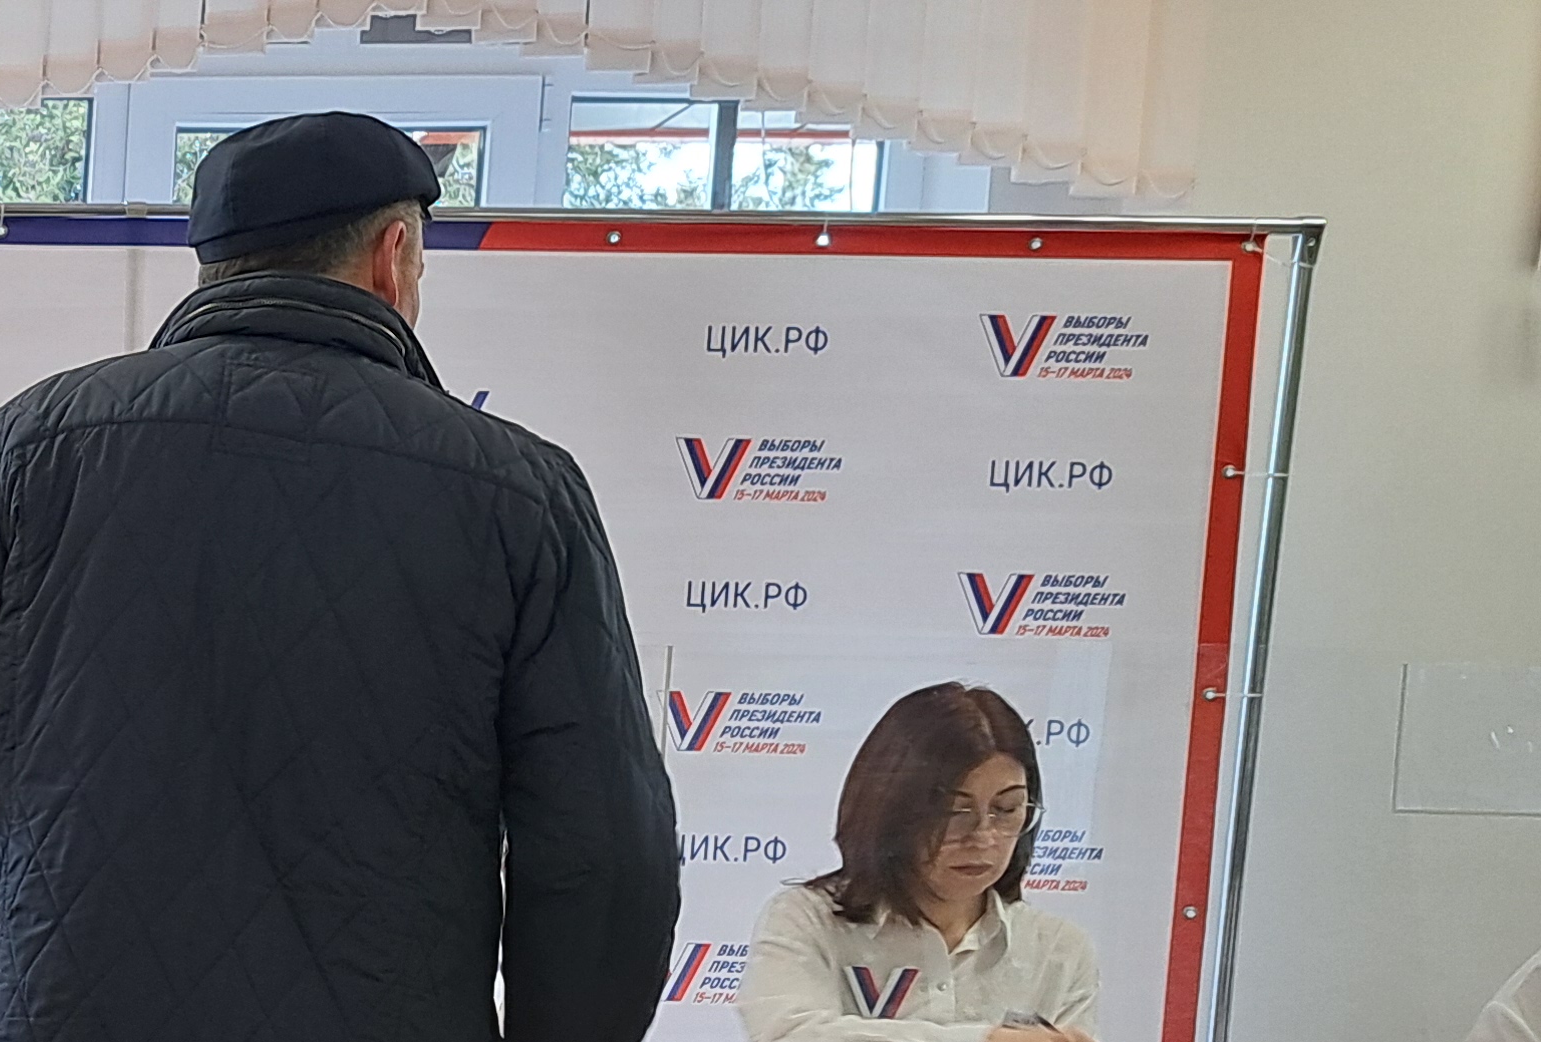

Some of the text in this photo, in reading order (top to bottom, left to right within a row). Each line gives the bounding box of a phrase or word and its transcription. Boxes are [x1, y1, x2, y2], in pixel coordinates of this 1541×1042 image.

[1062, 315, 1132, 330] ВЫБОРЫ
[706, 325, 828, 358] ЦИК.РФ
[1053, 333, 1149, 348] ПРЕЗИДЕНТА
[1044, 350, 1107, 364] РОССИИ
[1068, 367, 1105, 379] МАРТА
[1105, 367, 1132, 380] 2024
[757, 439, 825, 453] ВЫБОРЫ
[748, 456, 842, 471] ПРЕЗИДЕНТА
[740, 473, 801, 486] РОССИИ
[989, 459, 1112, 493] ЦИК.РФ
[763, 490, 800, 501] МАРТА
[800, 490, 827, 502] 2024
[1040, 574, 1109, 588] ВЫБОРЫ
[686, 580, 808, 613] ЦИК.РФ
[1031, 591, 1126, 607] ПРЕЗИДЕНТА
[1022, 608, 1085, 622] РОССИИ
[1046, 625, 1082, 637] МАРТА
[1082, 626, 1110, 638] 2024
[737, 693, 804, 706] ВЫБОРЫ
[728, 709, 822, 724] ПРЕЗИДЕНТА
[719, 726, 781, 739] РОССИИ
[742, 742, 779, 754] МАРТА
[779, 743, 807, 755] 2024
[1037, 830, 1086, 843] БОРЫ
[1031, 846, 1104, 860] ЕЗИДЕНТА
[700, 977, 741, 989] РОСС
